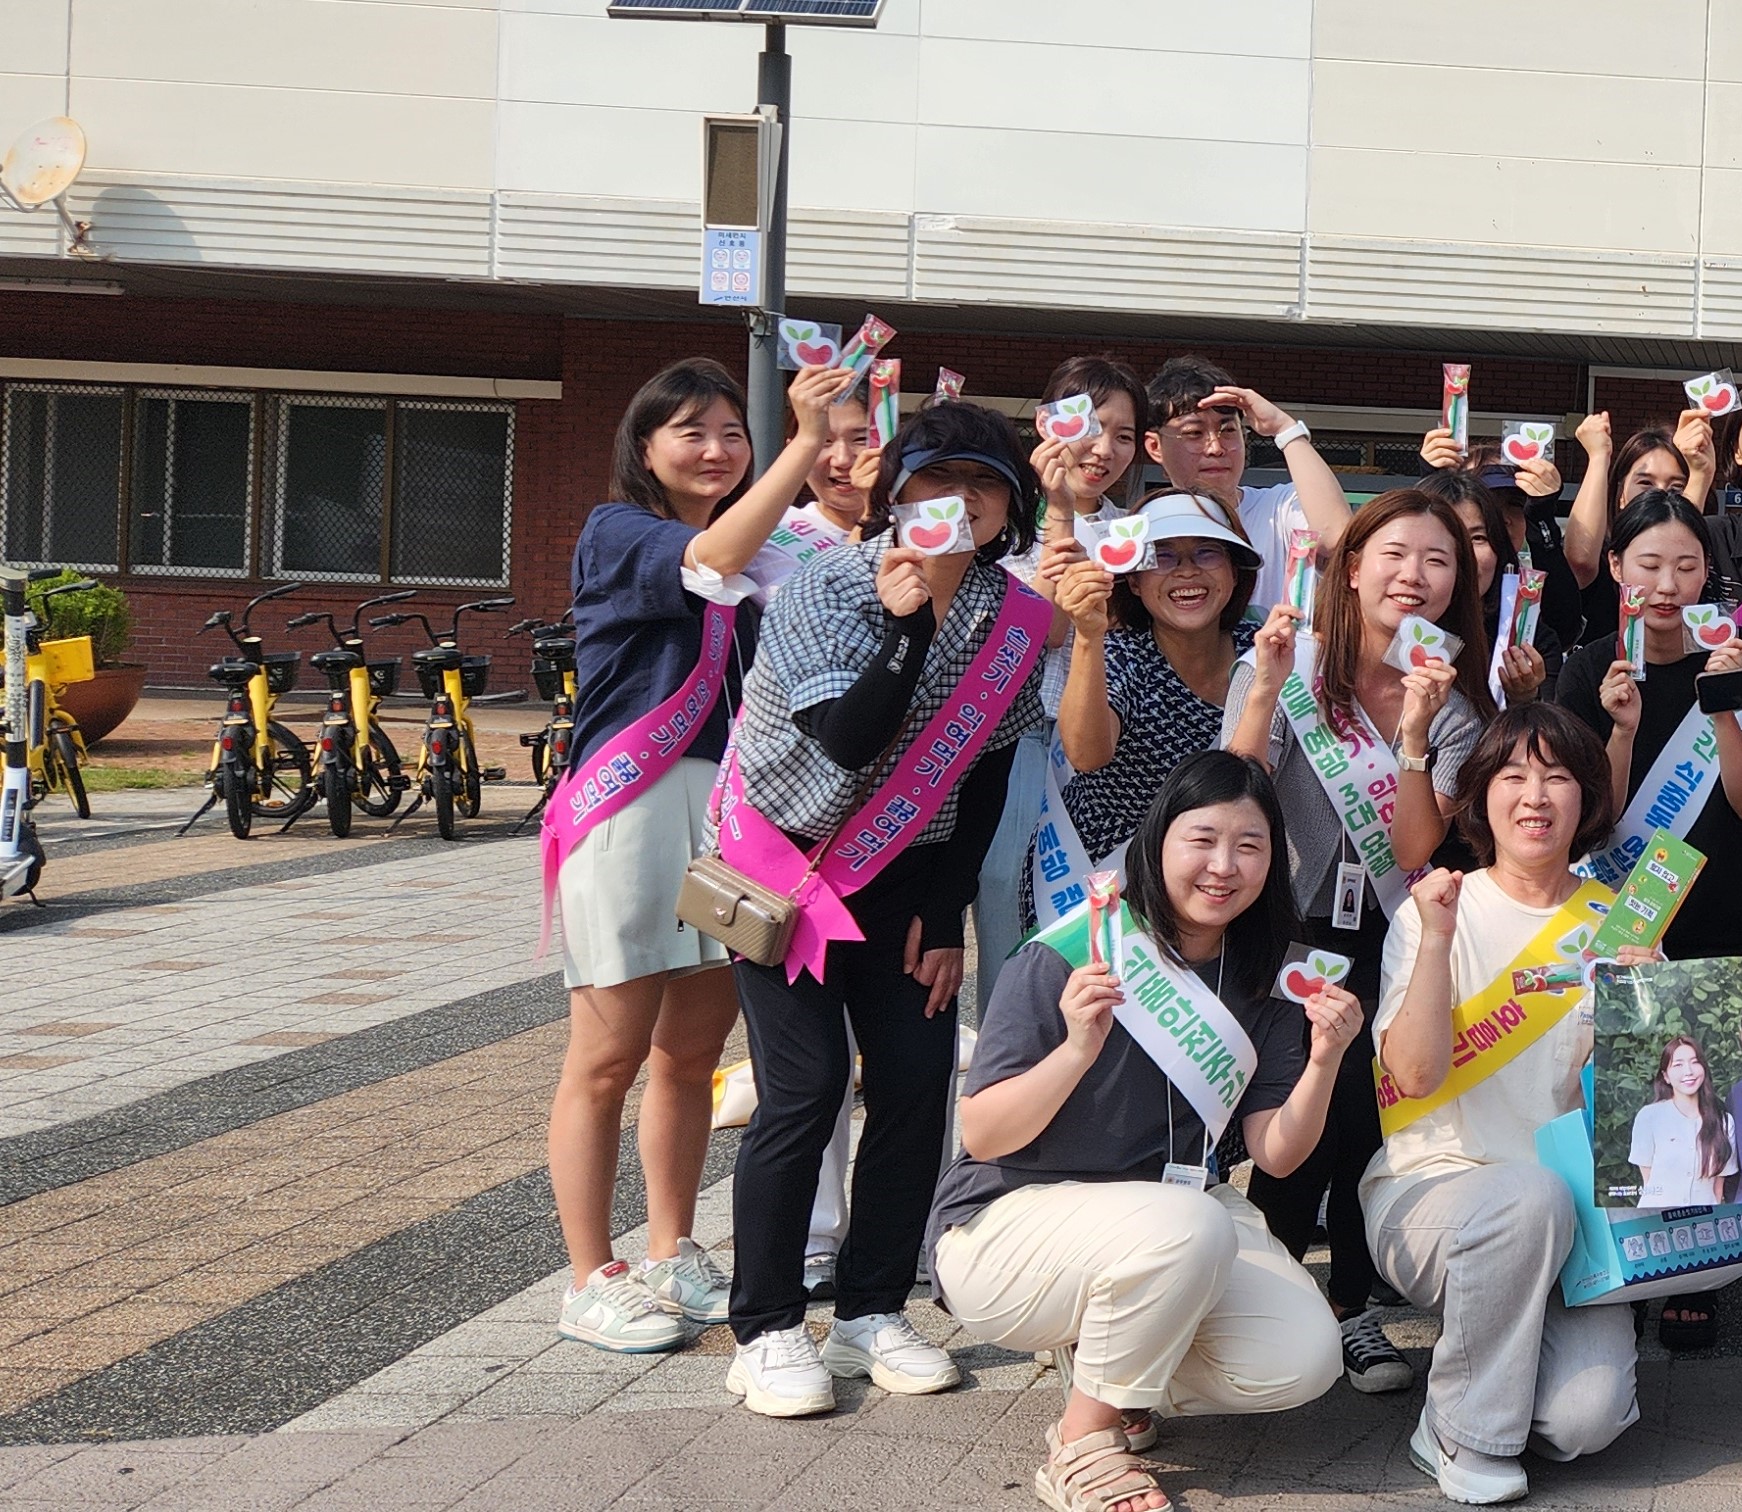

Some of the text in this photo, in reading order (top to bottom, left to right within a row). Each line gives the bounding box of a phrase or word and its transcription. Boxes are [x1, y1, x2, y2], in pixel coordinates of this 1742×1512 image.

[649, 678, 712, 757] 익혀먹기
[836, 625, 1031, 872] 손씻기 익혀먹기 끓여먹기
[1303, 722, 1349, 779] 예방
[570, 751, 643, 826] 끓여먹기
[1644, 761, 1704, 830] 식중독
[1039, 822, 1071, 883] 예방
[1123, 945, 1246, 1109] 식품안전주간
